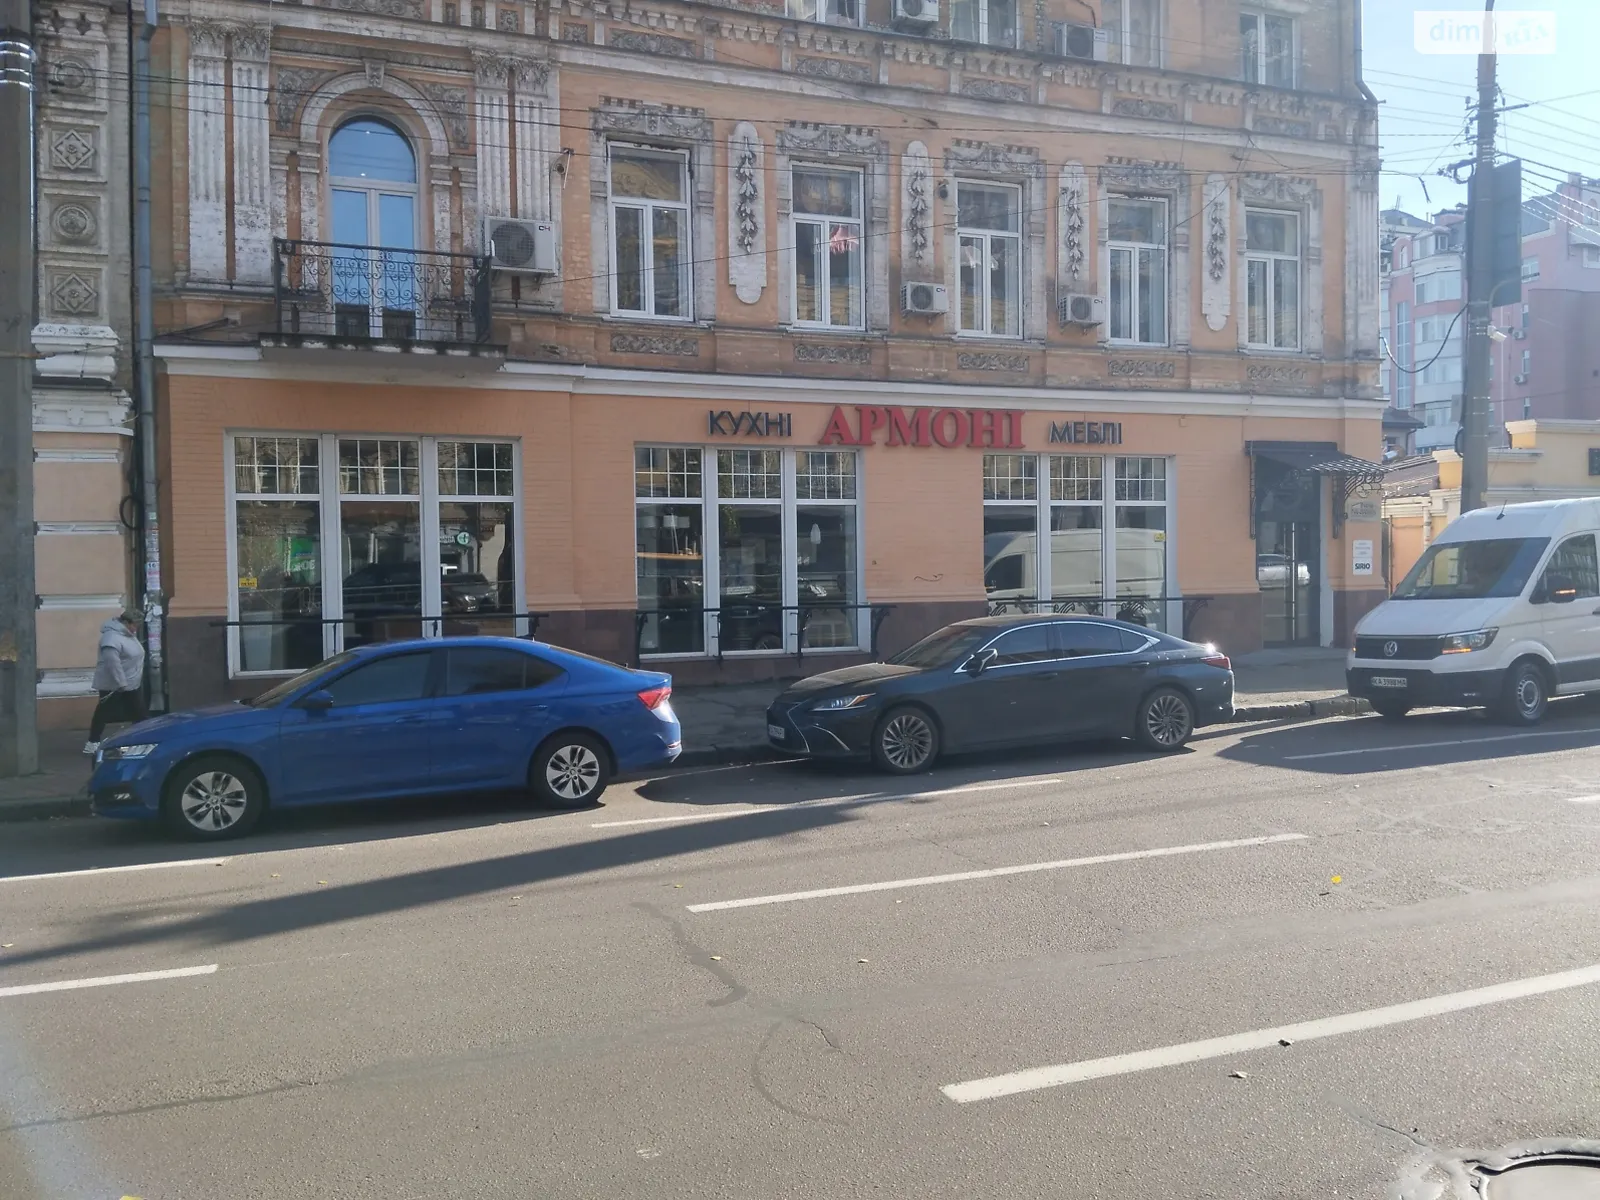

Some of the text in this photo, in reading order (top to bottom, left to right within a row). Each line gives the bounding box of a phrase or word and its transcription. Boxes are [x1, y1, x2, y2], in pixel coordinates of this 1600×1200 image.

[708, 405, 1123, 449] КУХНІ АРМОНІ МЕБЛІ
